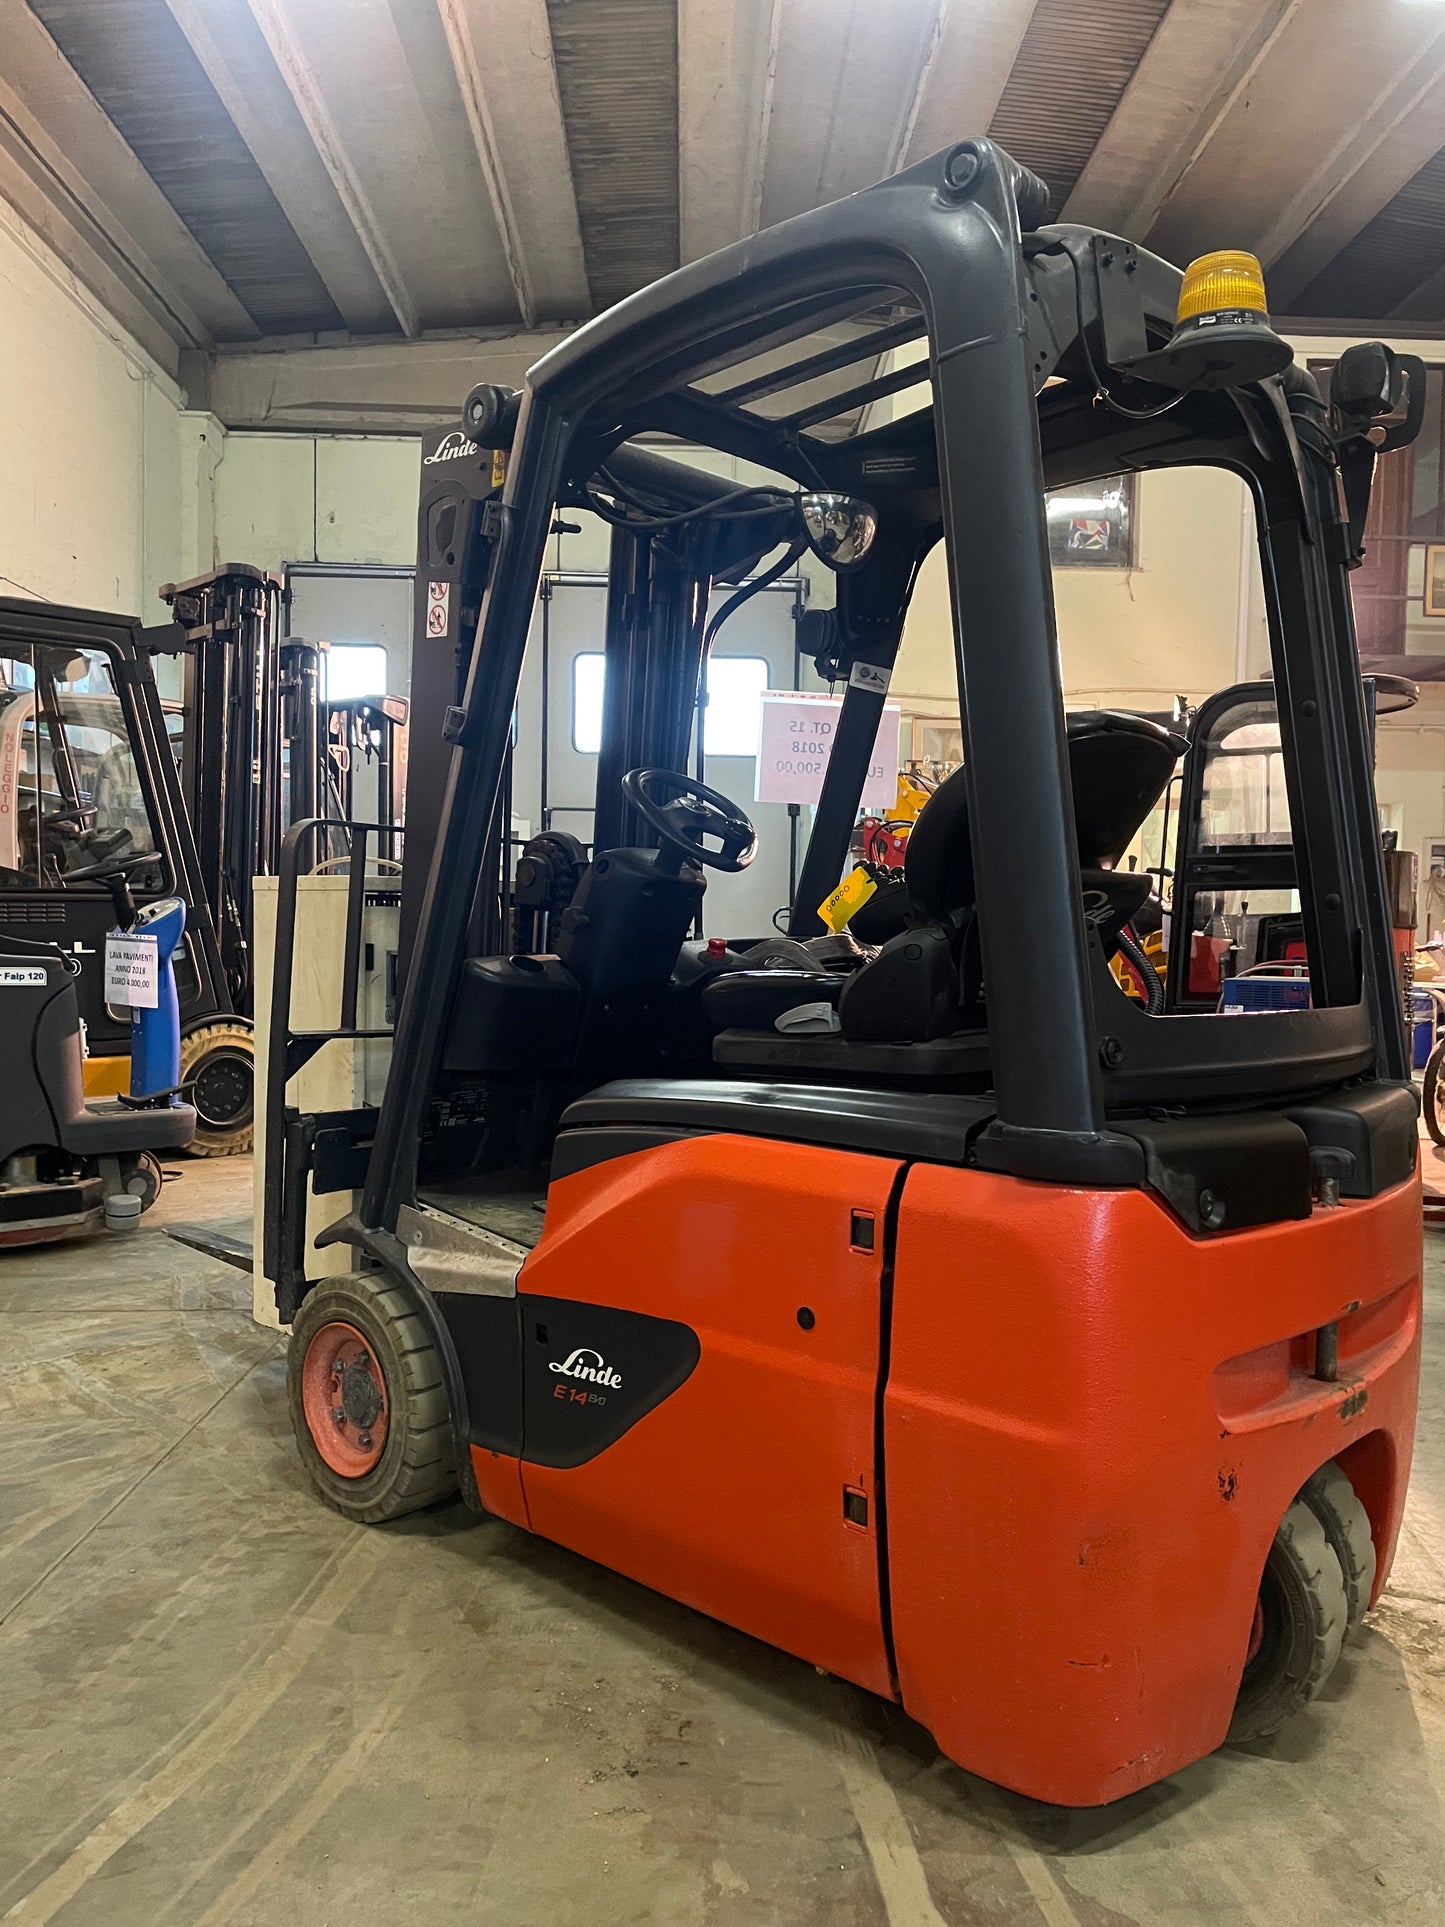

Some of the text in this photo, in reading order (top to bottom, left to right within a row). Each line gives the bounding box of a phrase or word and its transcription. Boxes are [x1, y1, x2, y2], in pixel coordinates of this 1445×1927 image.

[423, 432, 478, 465] Linde
[0, 732, 14, 814] NOLEGGIO
[110, 951, 153, 962] LAVA PAVIMENTI
[115, 965, 146, 975] ANNO 2018
[28, 972, 44, 980] 120
[111, 977, 126, 985] EURO
[548, 1348, 622, 1389] Linde
